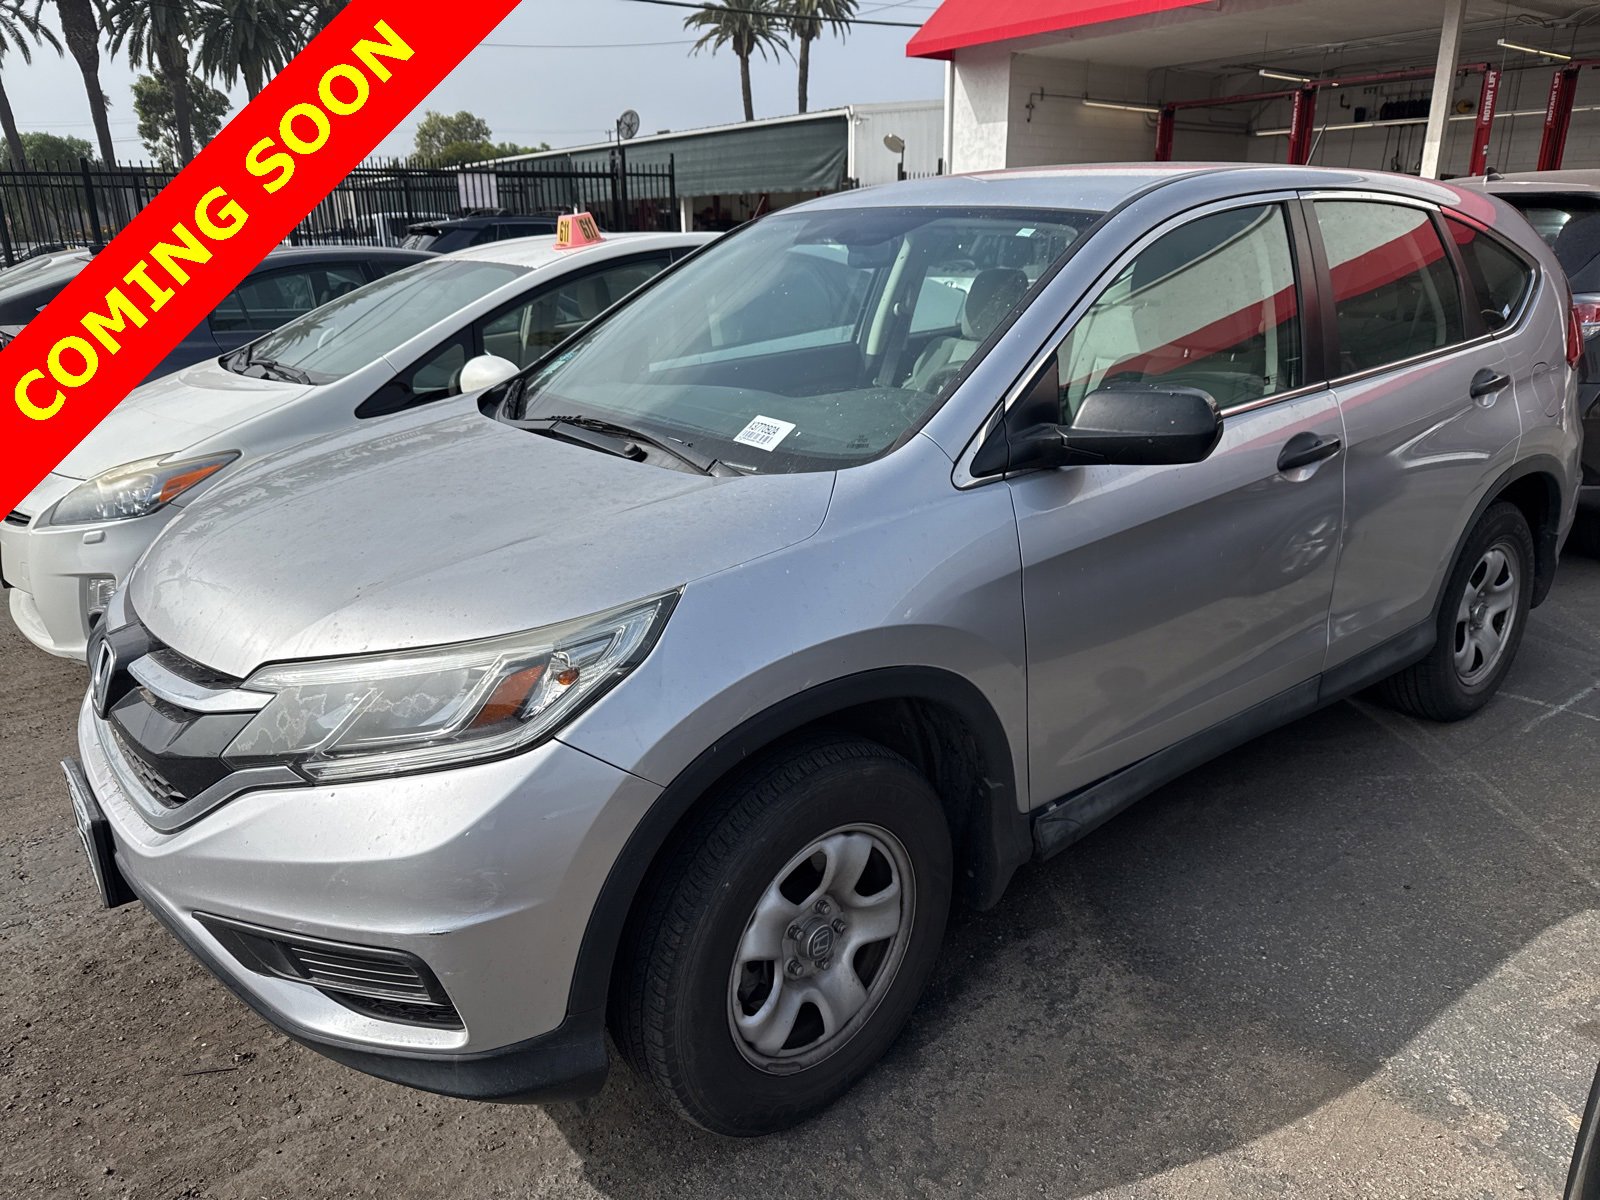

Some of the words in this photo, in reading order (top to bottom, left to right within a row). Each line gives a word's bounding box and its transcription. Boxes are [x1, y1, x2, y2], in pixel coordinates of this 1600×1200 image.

[1483, 90, 1493, 121] ROTARY
[1488, 71, 1496, 88] LIFT
[1547, 90, 1557, 122] ROTARY
[1553, 72, 1561, 89] LIFT
